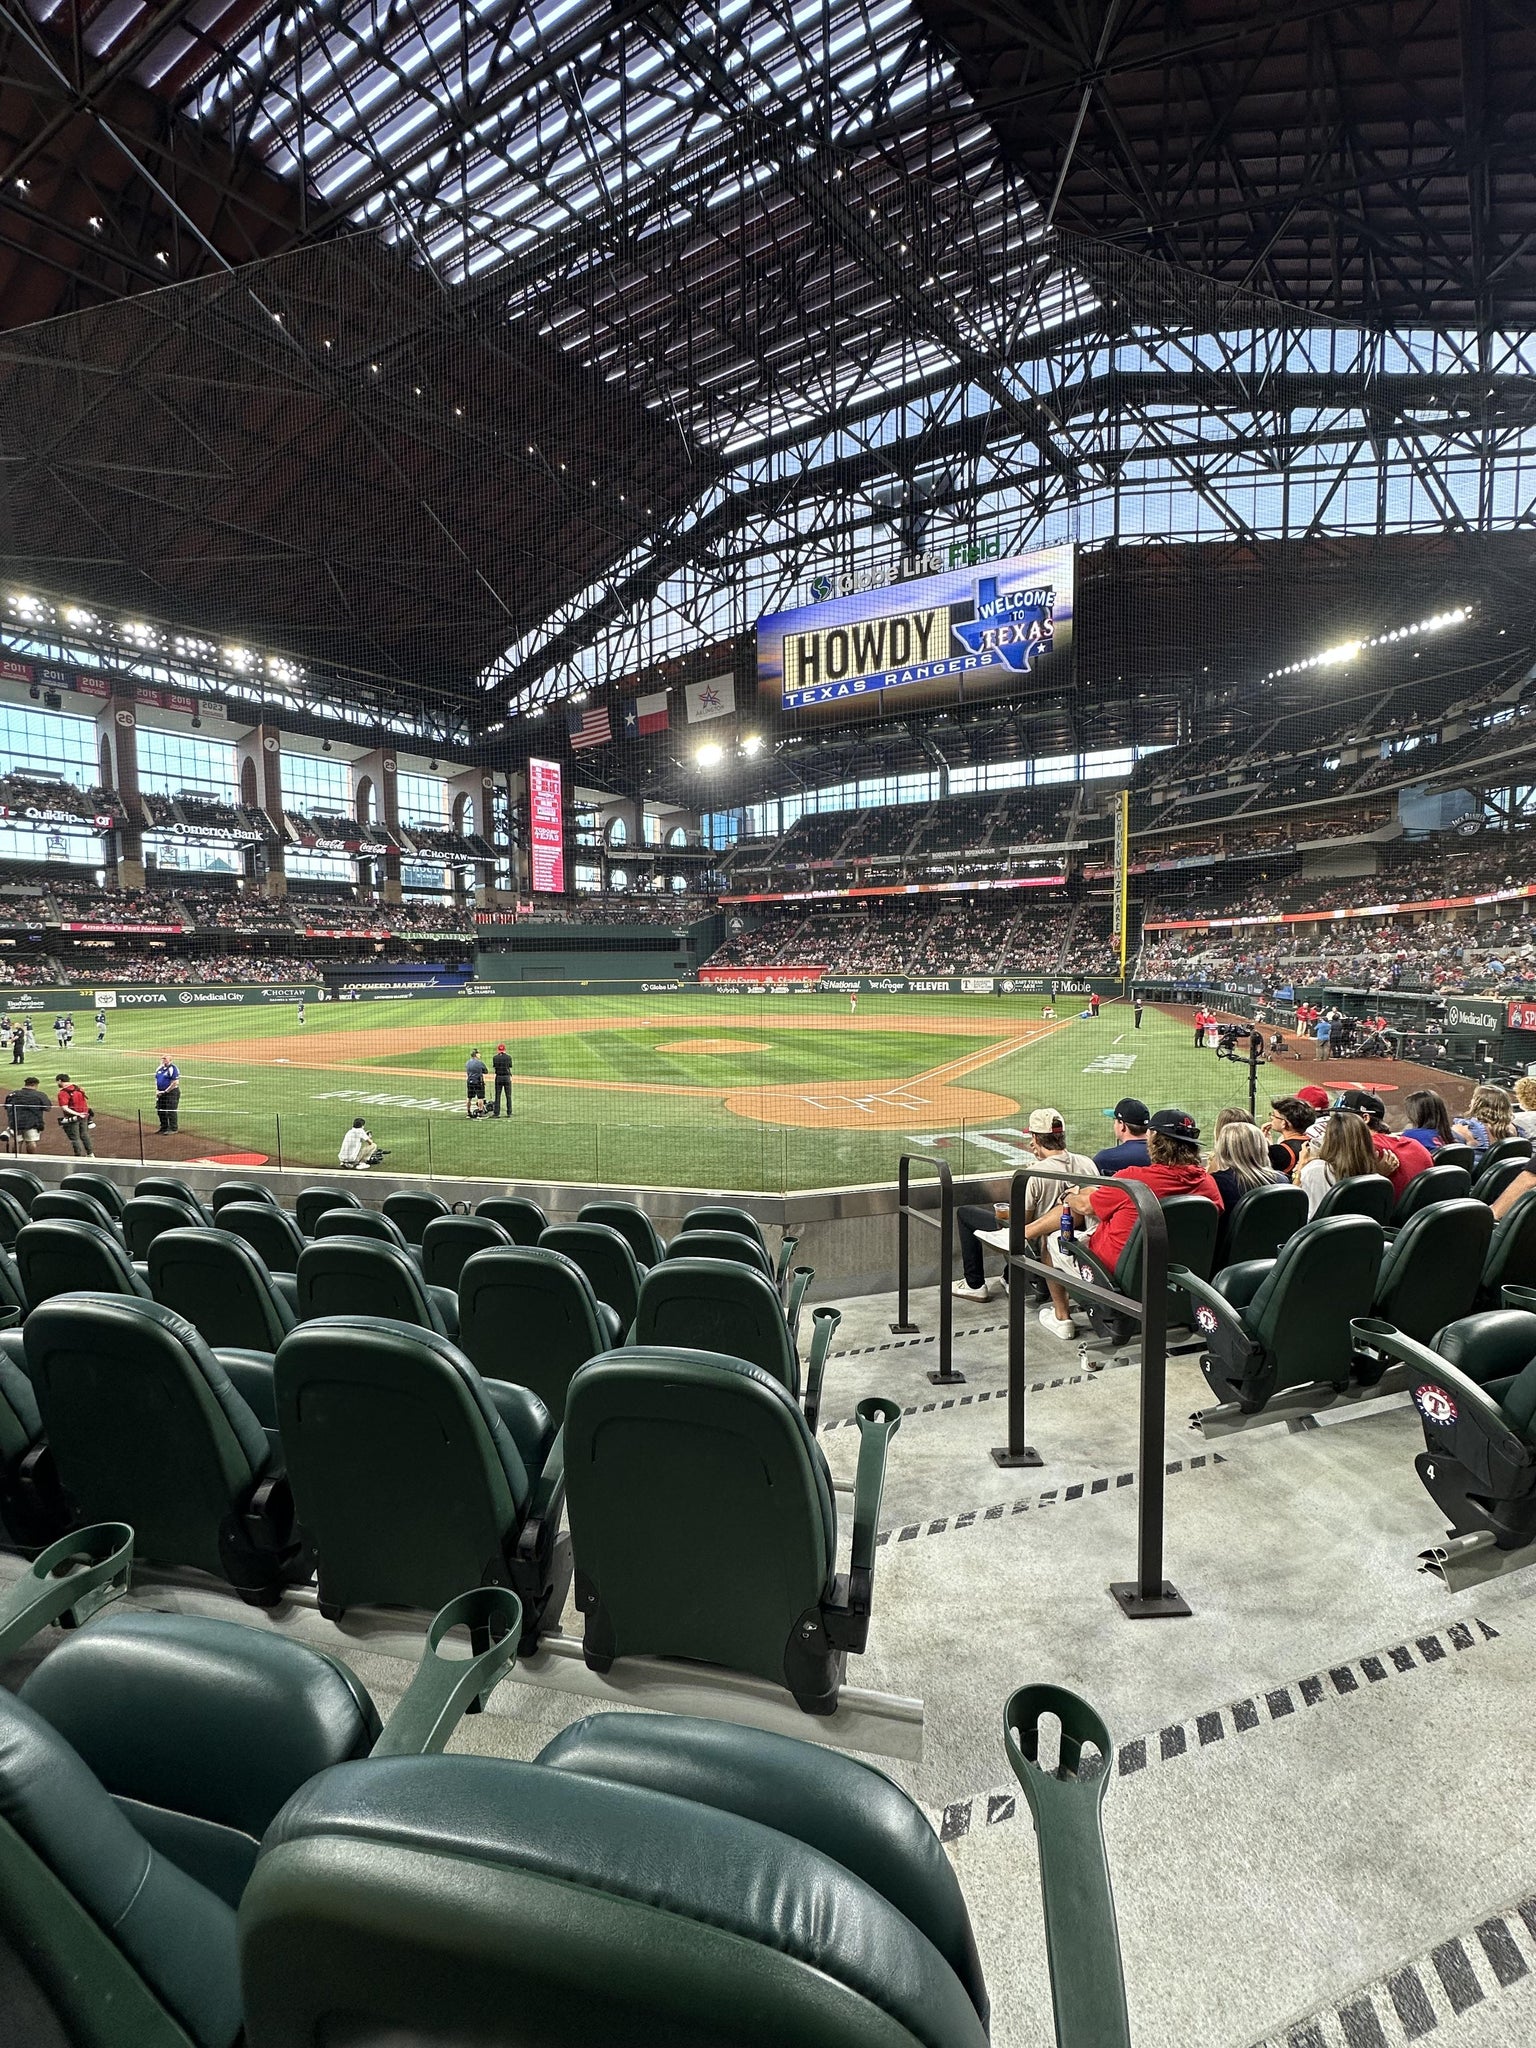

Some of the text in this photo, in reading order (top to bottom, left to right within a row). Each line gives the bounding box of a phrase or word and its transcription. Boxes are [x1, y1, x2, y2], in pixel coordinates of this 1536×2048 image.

[838, 535, 1000, 592] Globe Life Field
[980, 591, 1056, 619] WELCOME
[1012, 610, 1025, 621] TO
[982, 618, 1054, 649] TEXAS
[797, 612, 936, 686] HOWDY
[3, 661, 26, 673] 2011
[43, 669, 65, 681] 2011
[785, 654, 993, 706] TEXAS RANGERS
[82, 677, 105, 689] 2012
[136, 688, 158, 699] 2015
[202, 701, 224, 712] 2023
[118, 713, 133, 724] 26
[268, 741, 275, 749] 7
[25, 807, 79, 824] QuikTrip
[95, 816, 111, 827] QT
[232, 828, 264, 841] Bank
[425, 849, 468, 861] CHOCTAW
[123, 924, 140, 932] Best
[829, 980, 861, 989] National
[879, 978, 905, 994] Kroger
[1060, 980, 1091, 993] Moble
[118, 994, 168, 1003] TOYOTA
[193, 992, 245, 1002] Medical City
[1459, 1011, 1498, 1032] Medical City
[1205, 1361, 1211, 1372] 3
[1428, 1394, 1446, 1417] T
[1426, 1464, 1436, 1480] 4
